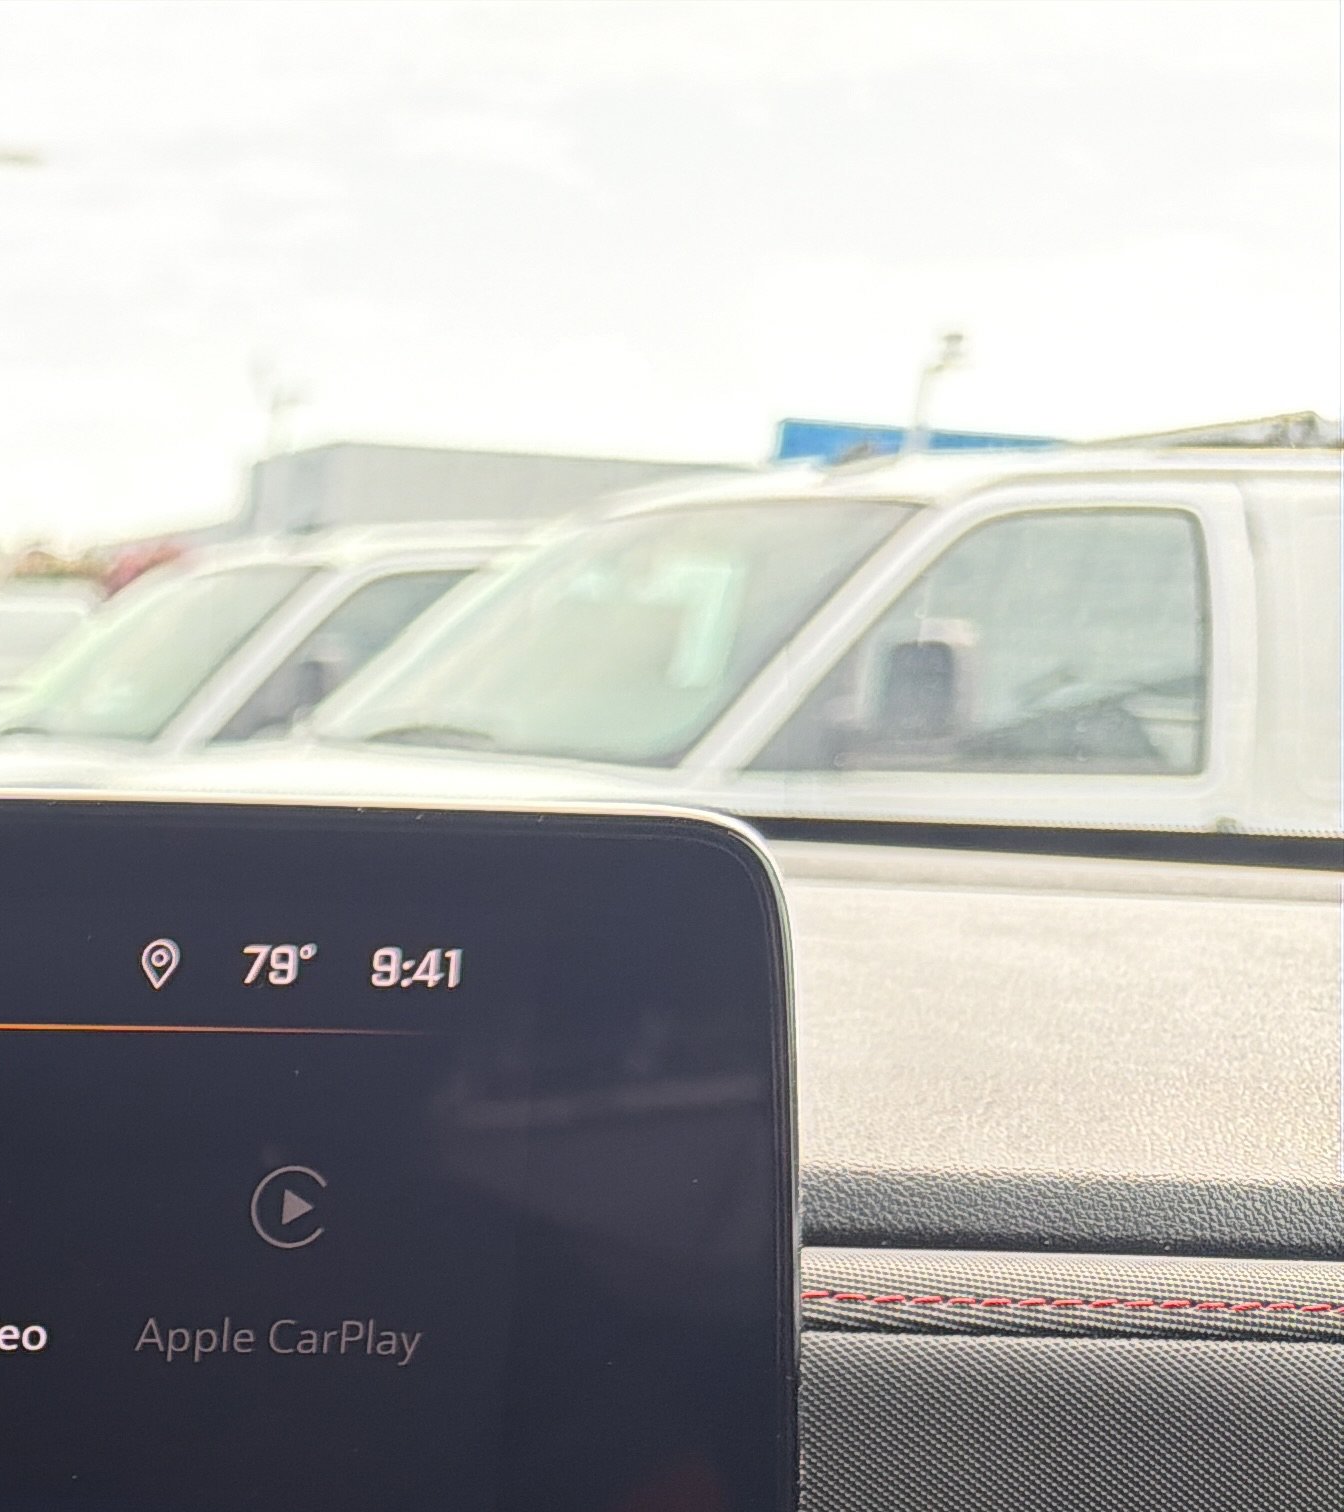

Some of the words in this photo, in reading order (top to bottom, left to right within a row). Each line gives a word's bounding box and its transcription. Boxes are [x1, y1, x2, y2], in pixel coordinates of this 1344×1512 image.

[243, 943, 317, 985] 79°
[371, 947, 462, 988] 9:41
[134, 1316, 255, 1363] Apple
[269, 1319, 422, 1366] CarPlay
